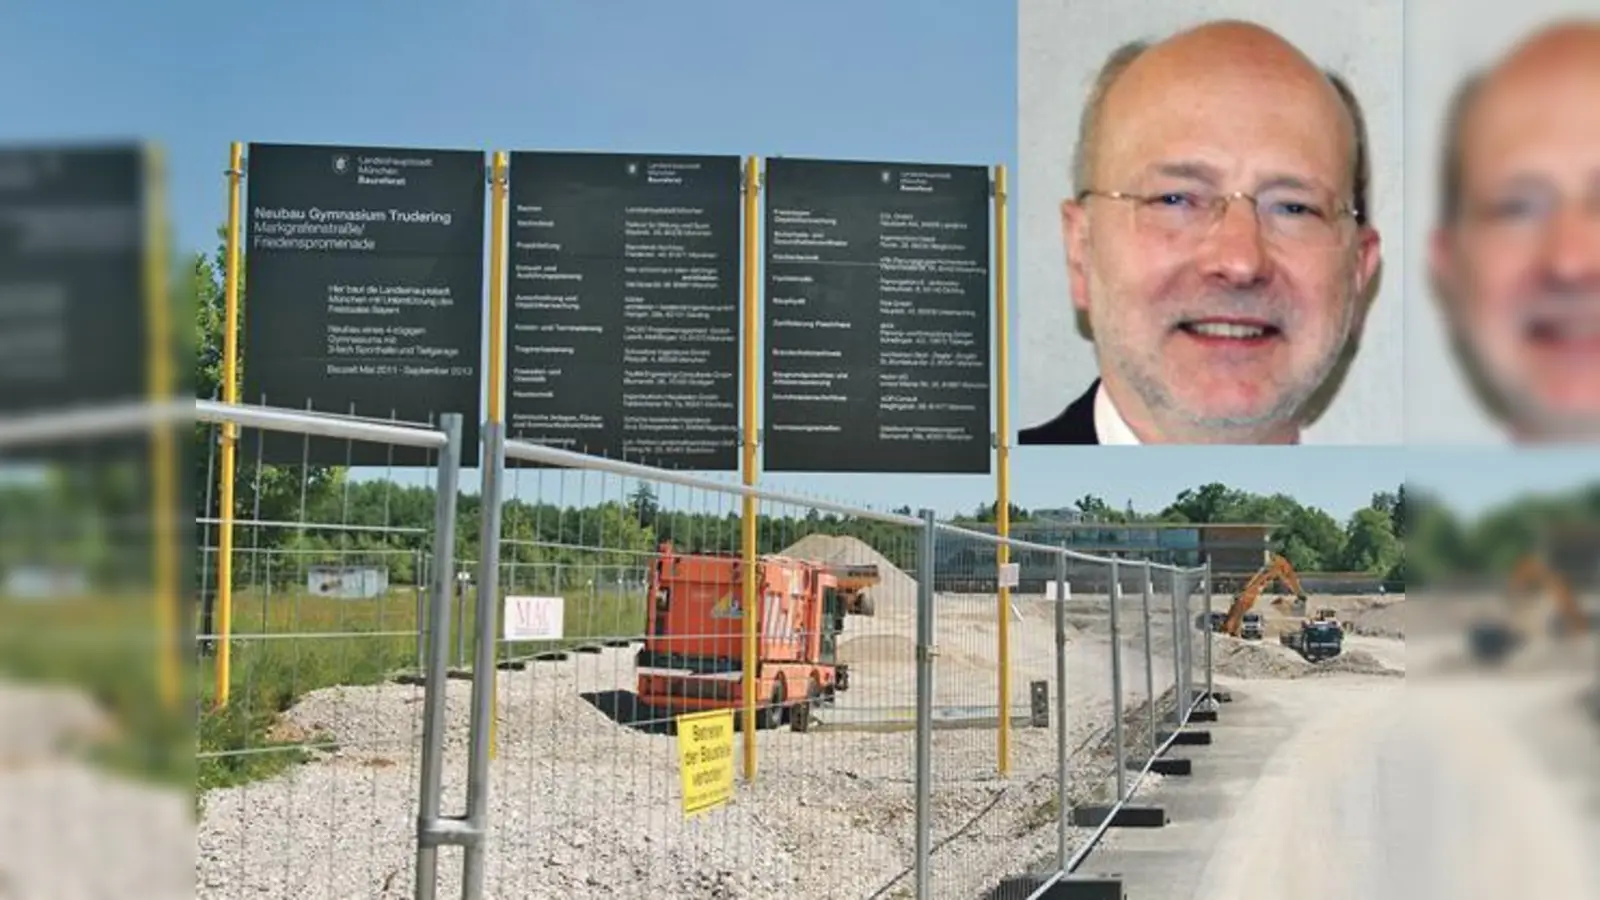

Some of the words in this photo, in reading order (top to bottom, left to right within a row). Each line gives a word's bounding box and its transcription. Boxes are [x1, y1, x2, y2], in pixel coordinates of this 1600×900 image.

[254, 206, 305, 220] Neubau
[309, 207, 386, 222] Gymnasium
[389, 209, 452, 225] Trudering
[254, 236, 376, 251] Friedenspromenade
